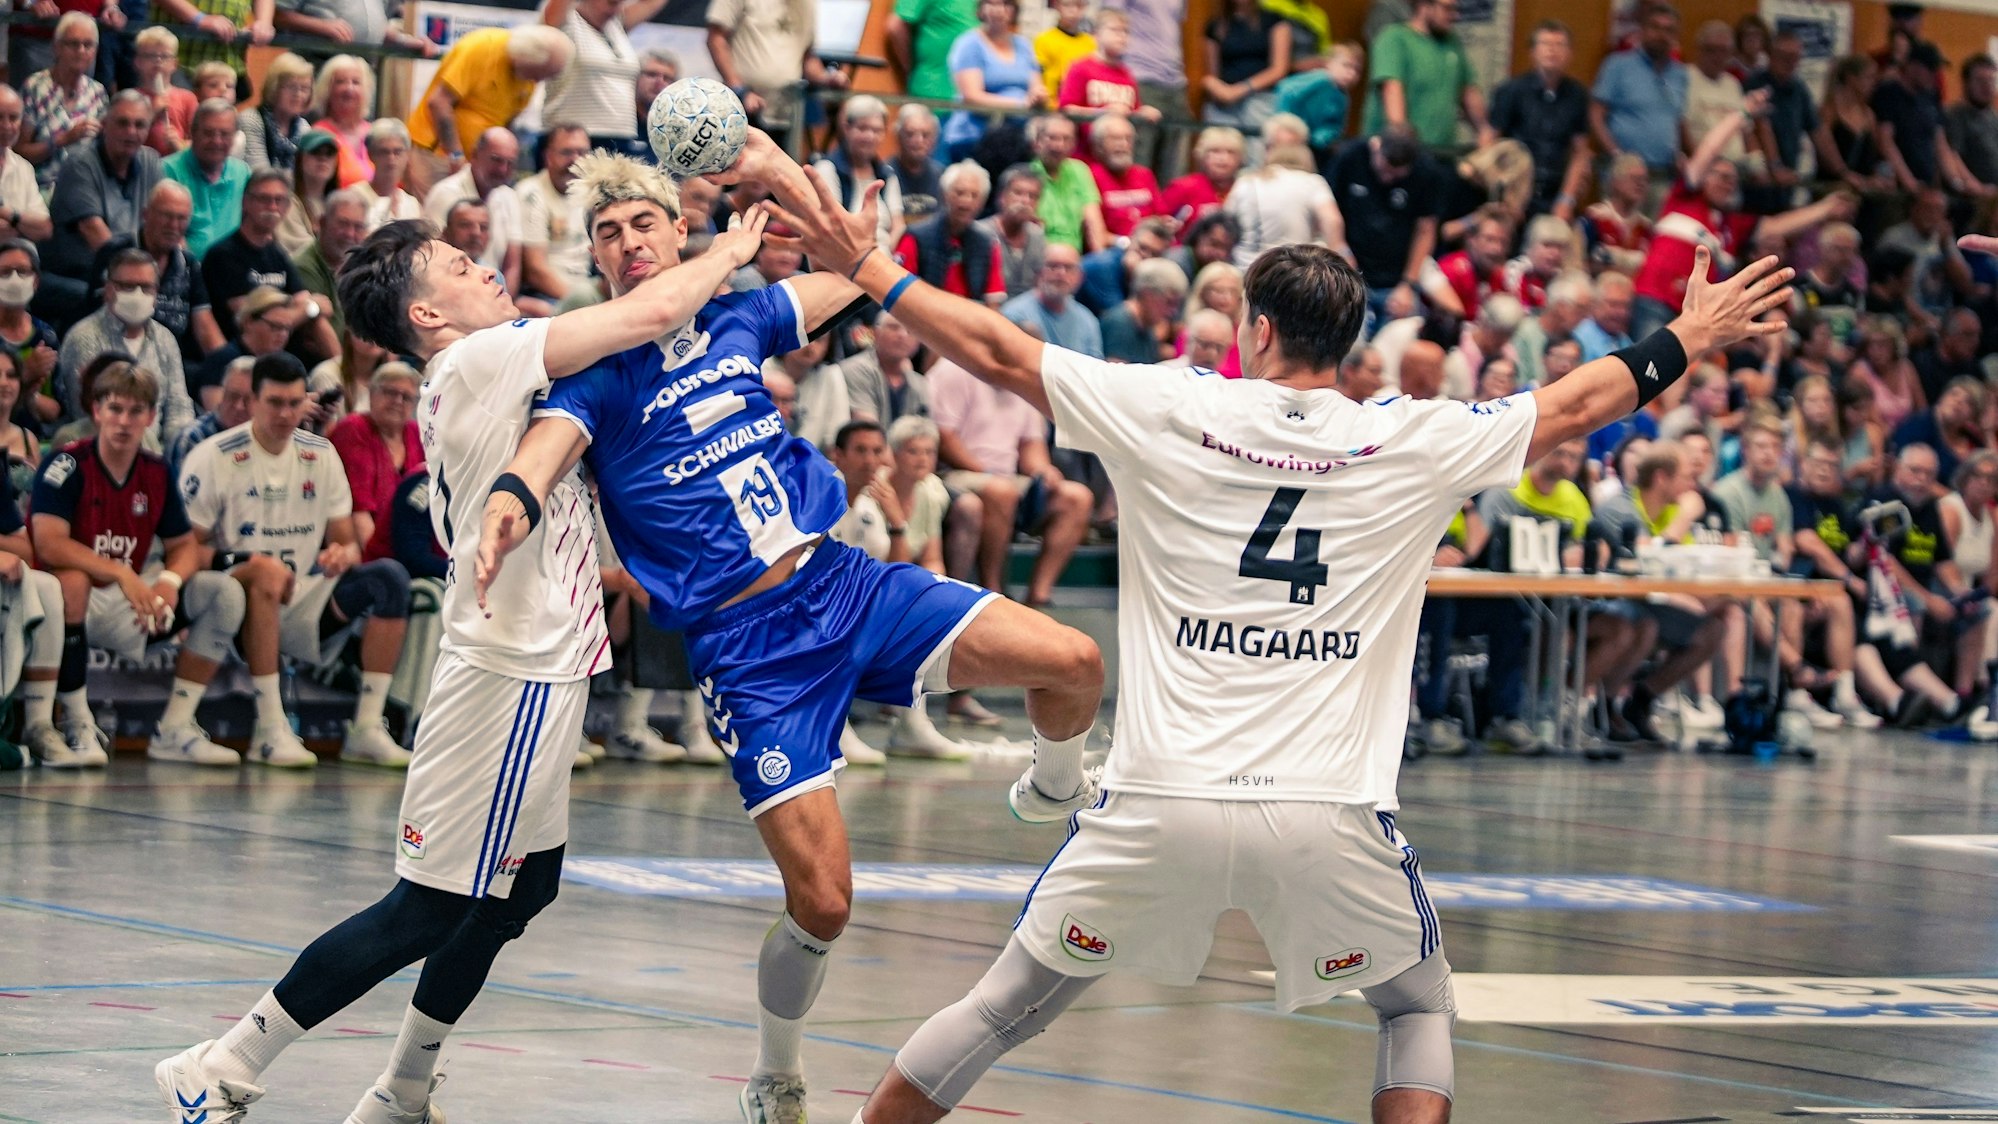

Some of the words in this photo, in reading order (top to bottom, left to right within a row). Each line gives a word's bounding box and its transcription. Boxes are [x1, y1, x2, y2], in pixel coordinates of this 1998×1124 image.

[677, 118, 718, 167] SELECT
[663, 411, 783, 486] SCHWALBE
[741, 466, 782, 525] 19
[94, 529, 137, 559] play
[1238, 486, 1328, 605] 4
[1176, 616, 1360, 662] MAGAARD
[1067, 924, 1107, 951] Dole
[1325, 952, 1364, 972] Dole
